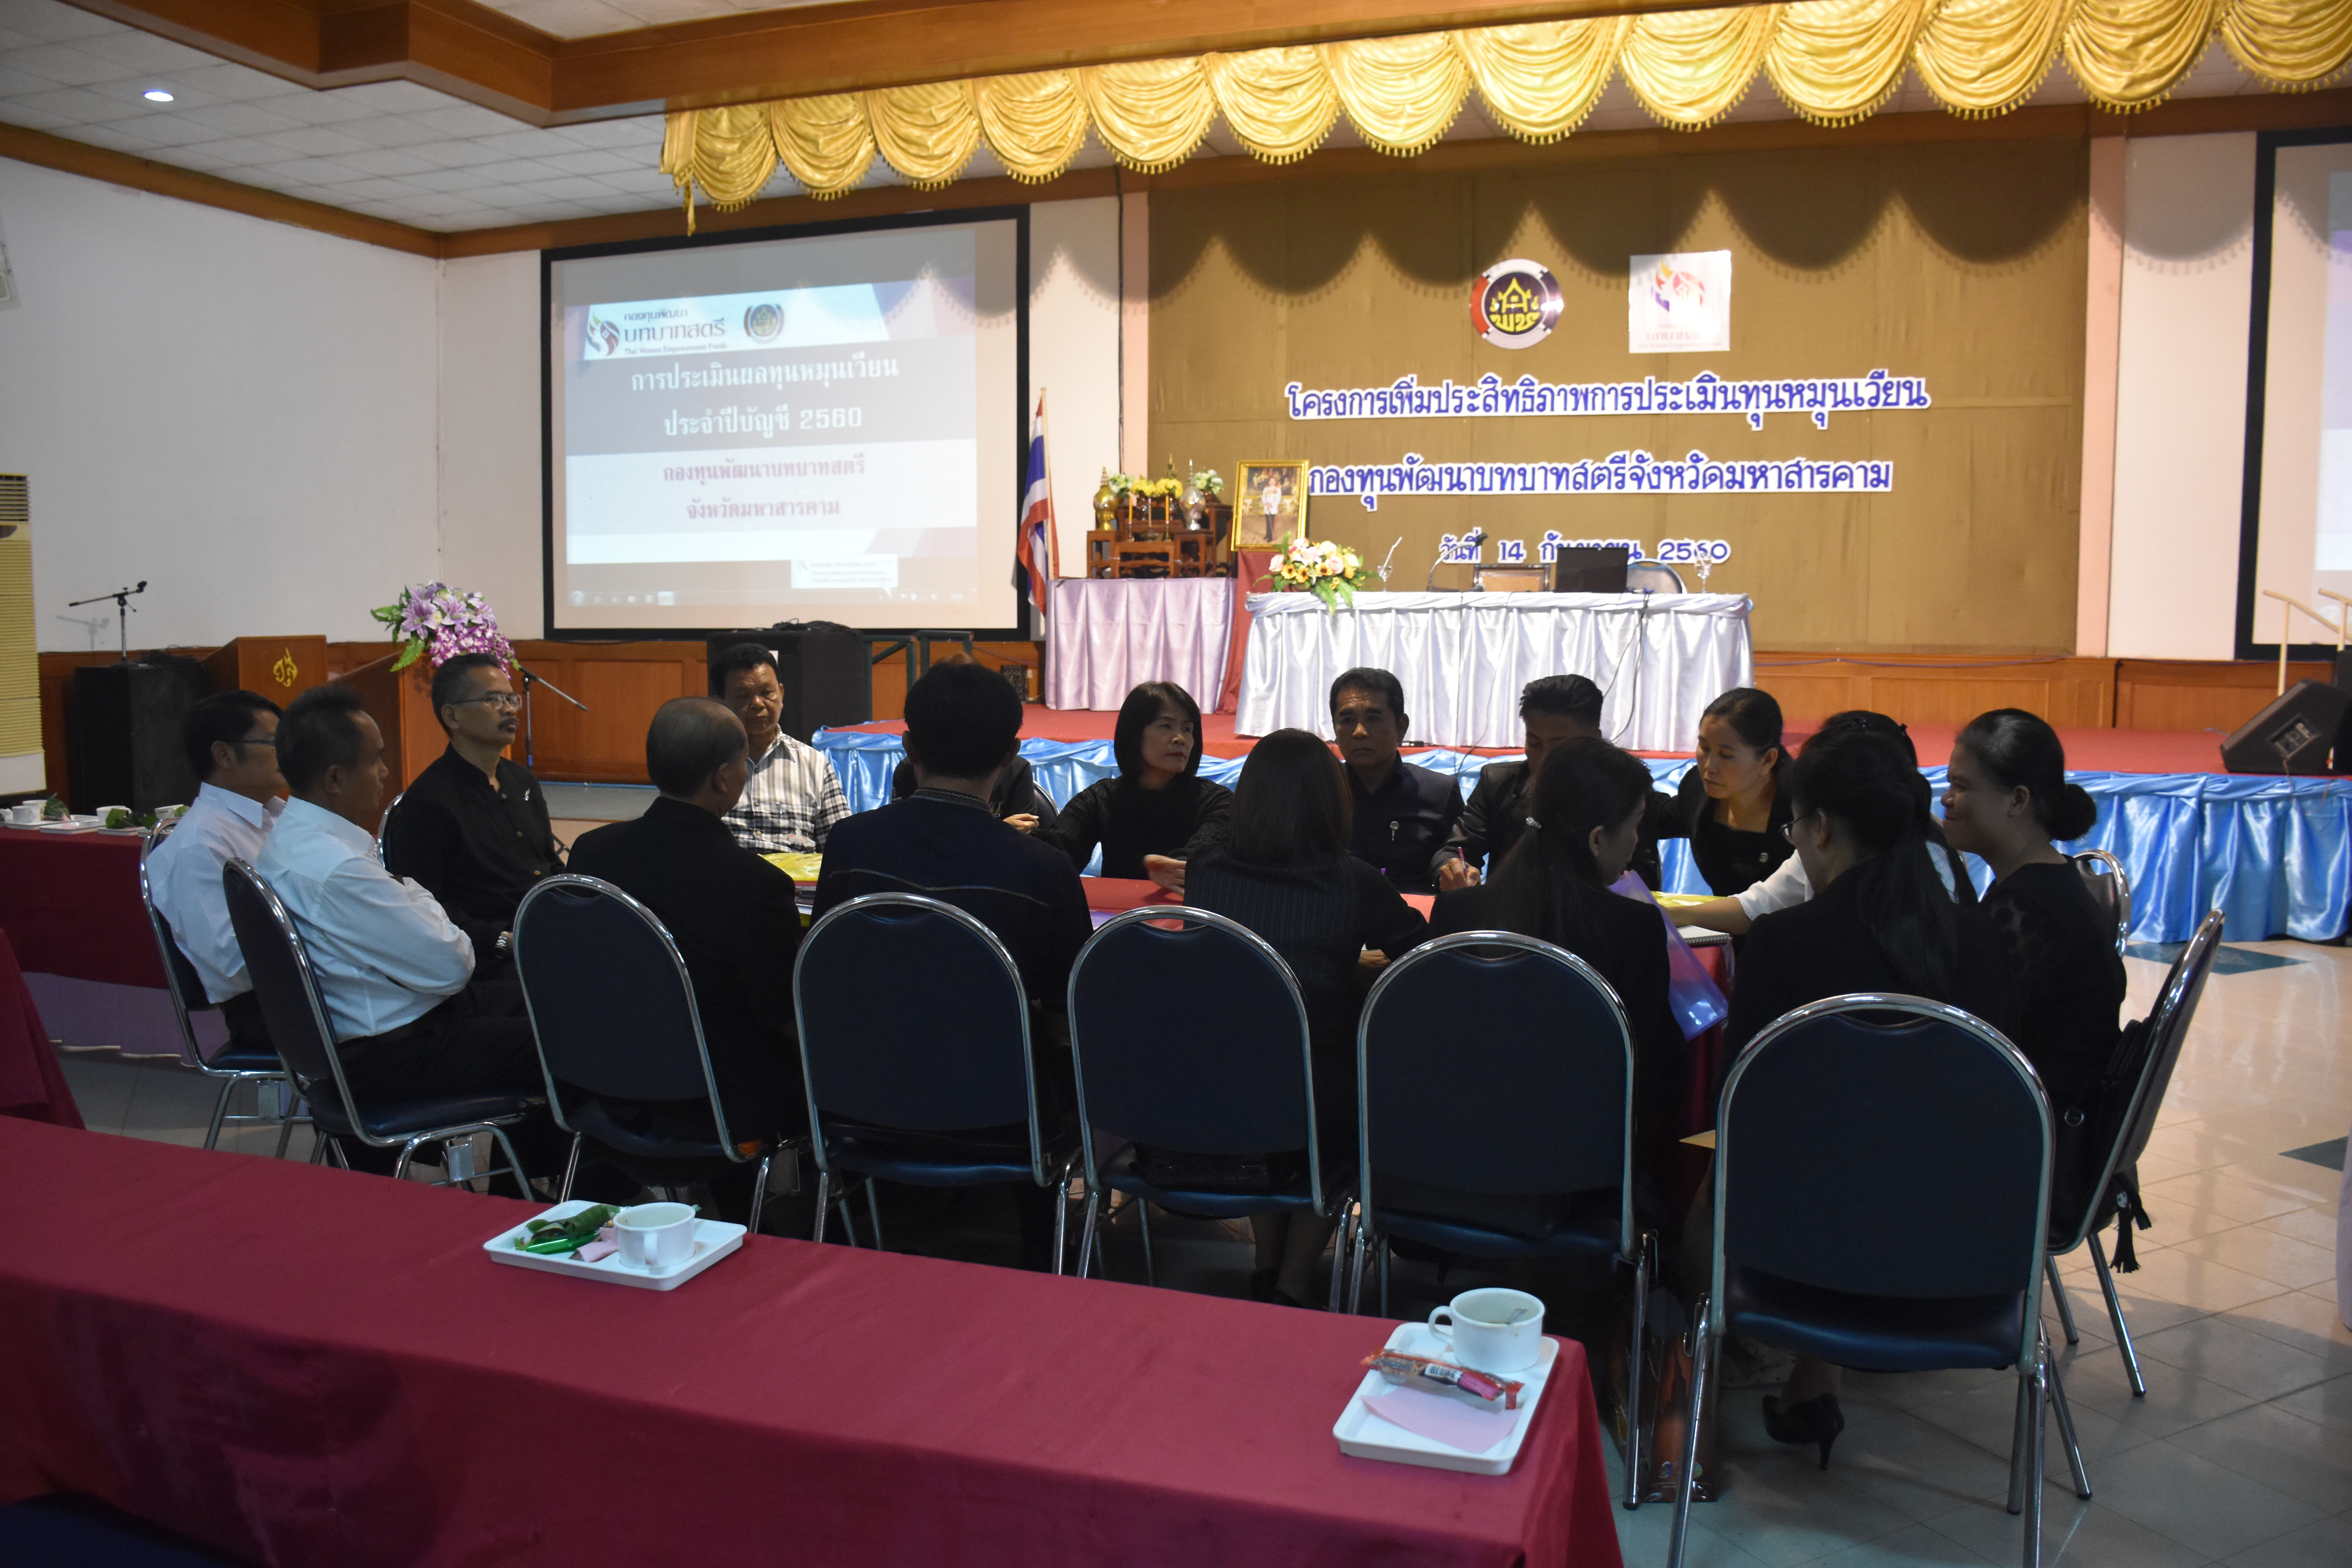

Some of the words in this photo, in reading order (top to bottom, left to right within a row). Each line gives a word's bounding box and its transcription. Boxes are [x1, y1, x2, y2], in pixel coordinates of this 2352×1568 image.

[624, 317, 726, 343] บทบาทสตรี
[631, 351, 899, 391] การประเมินผลทุนหมุนเวียน
[1288, 370, 1928, 427] โครงการเพิ่มประสิทธิภาพการประเมินทุนหมุนเวียน
[664, 403, 789, 439] ประจำปีบัญชี
[800, 407, 862, 430] 2560
[663, 452, 866, 486] กองทุนพัฒนาบทบาทสตรี
[1309, 453, 1890, 510] กองทุนพัฒนาบทบาทสตรีจังหวัดมหาสารคาม
[687, 497, 840, 519] จังหวัดมหาสารคาม
[1500, 542, 1524, 560] 14
